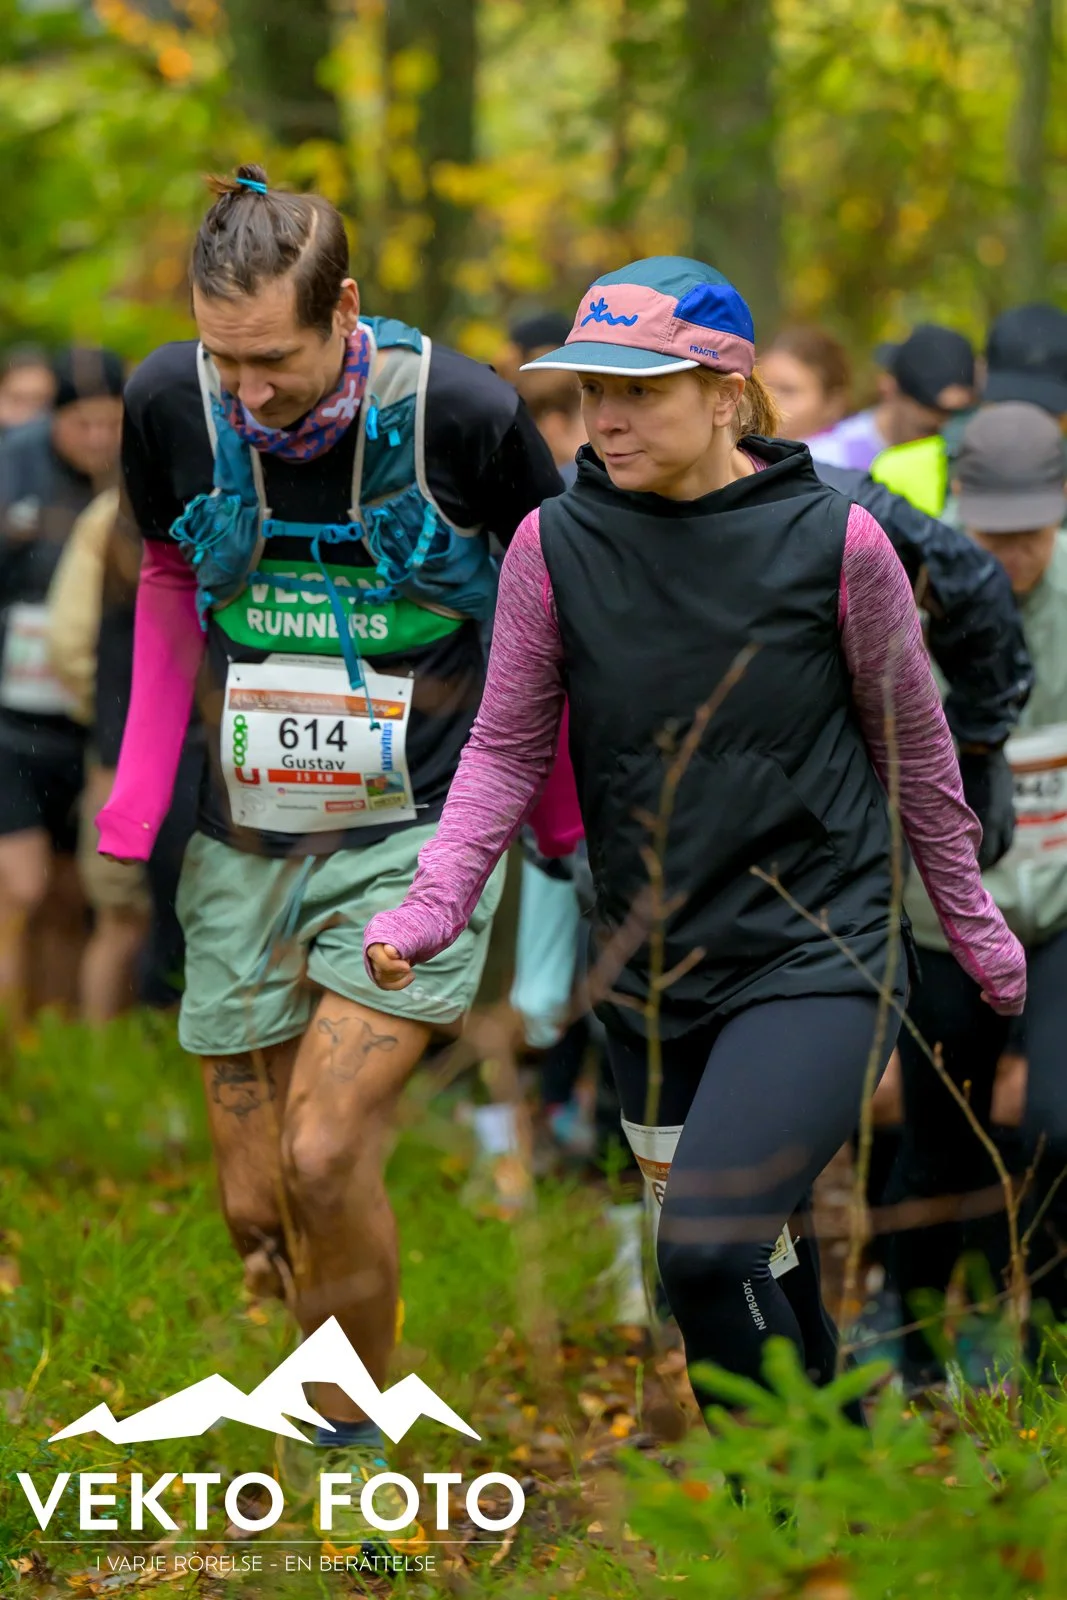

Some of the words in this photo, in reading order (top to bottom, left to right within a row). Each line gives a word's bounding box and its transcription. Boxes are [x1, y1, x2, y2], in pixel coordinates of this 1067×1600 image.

[690, 345, 719, 359] FRACTEL
[247, 608, 389, 640] RUNNERS
[233, 714, 249, 767] coop
[278, 717, 348, 752] 614
[281, 754, 347, 771] Gustav
